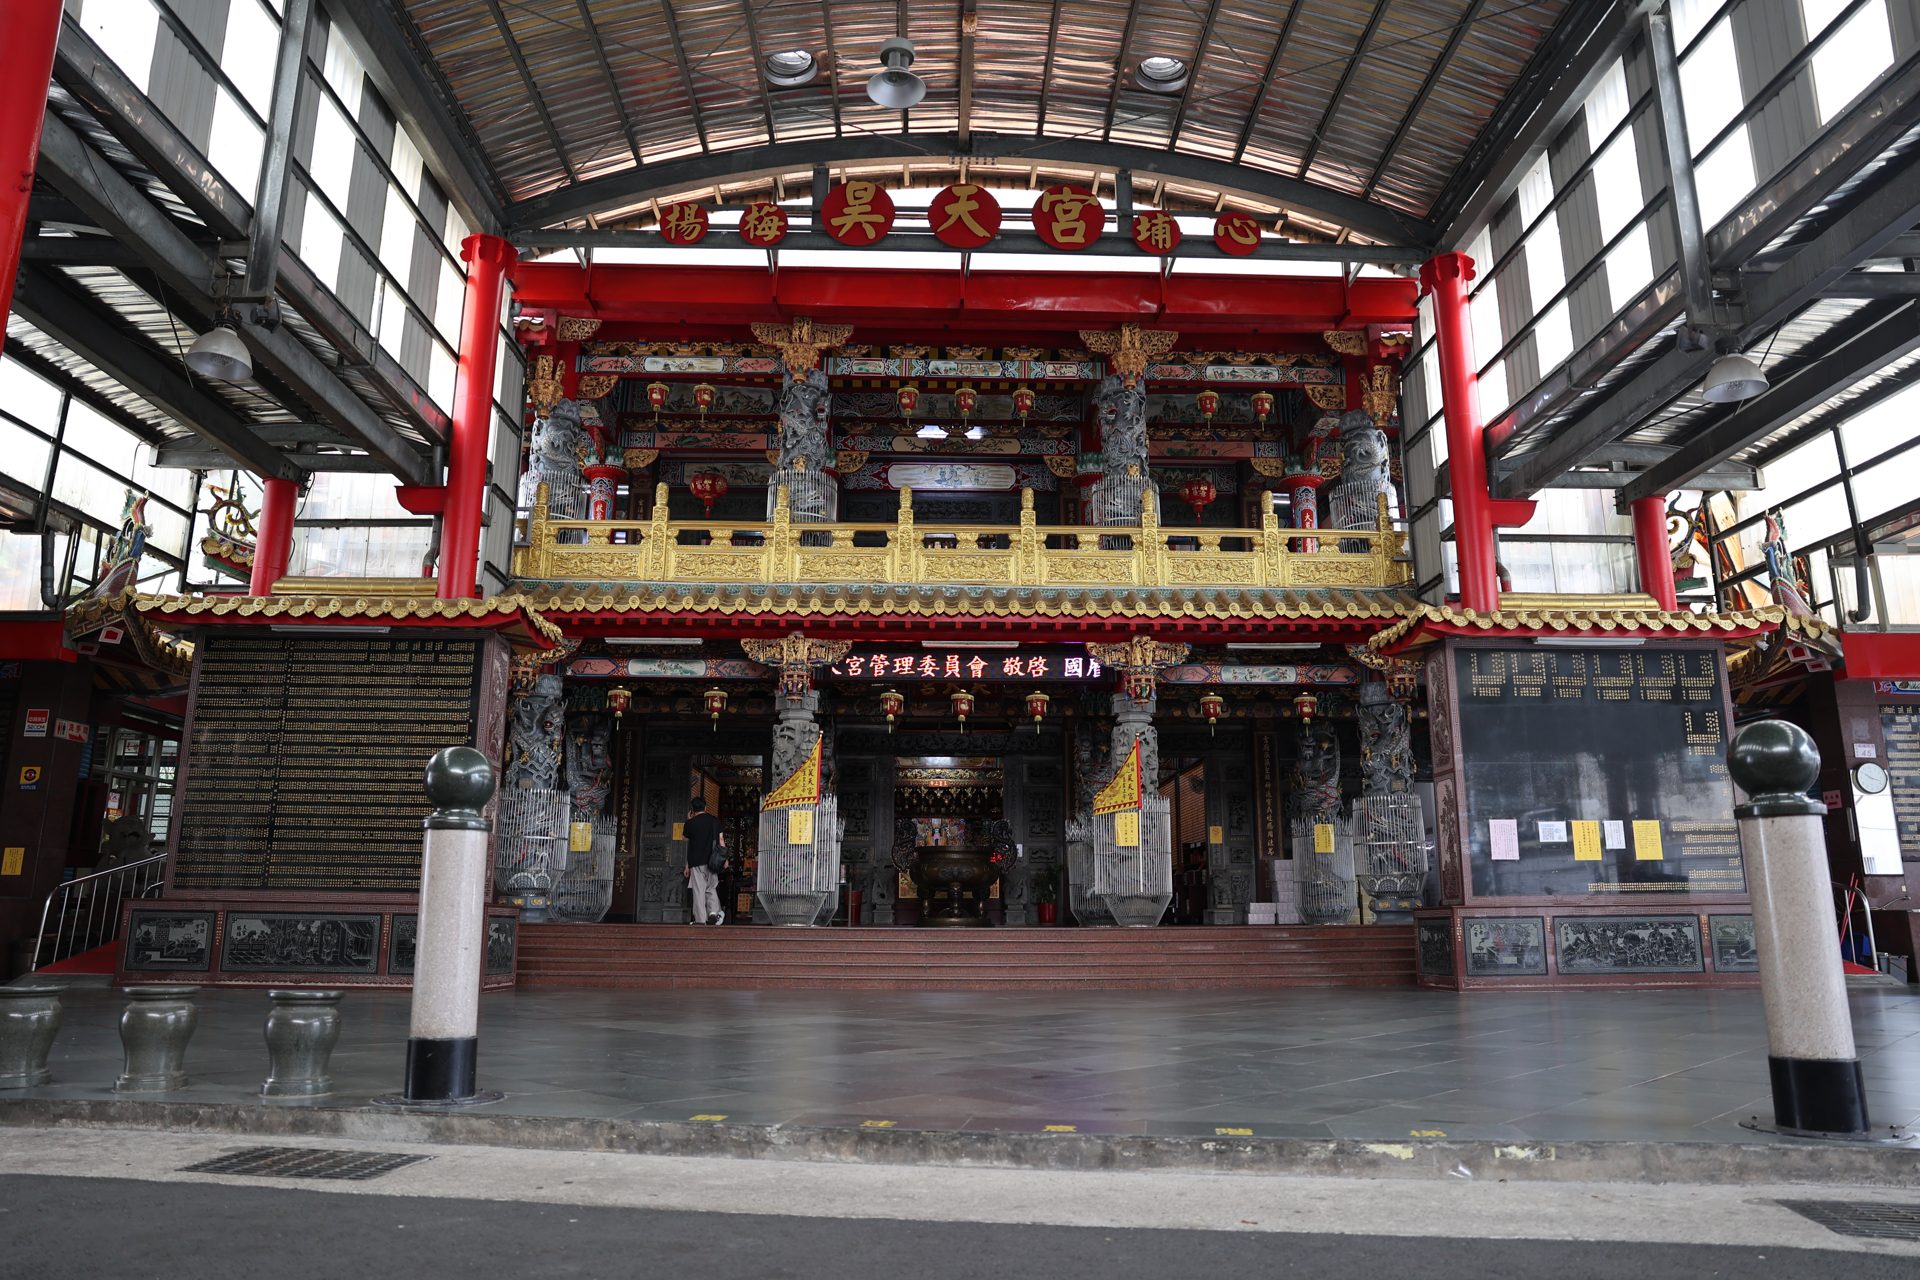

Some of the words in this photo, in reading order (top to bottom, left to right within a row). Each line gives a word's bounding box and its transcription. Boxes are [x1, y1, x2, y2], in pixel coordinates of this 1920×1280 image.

[831, 653, 989, 678] 宮管理委員會
